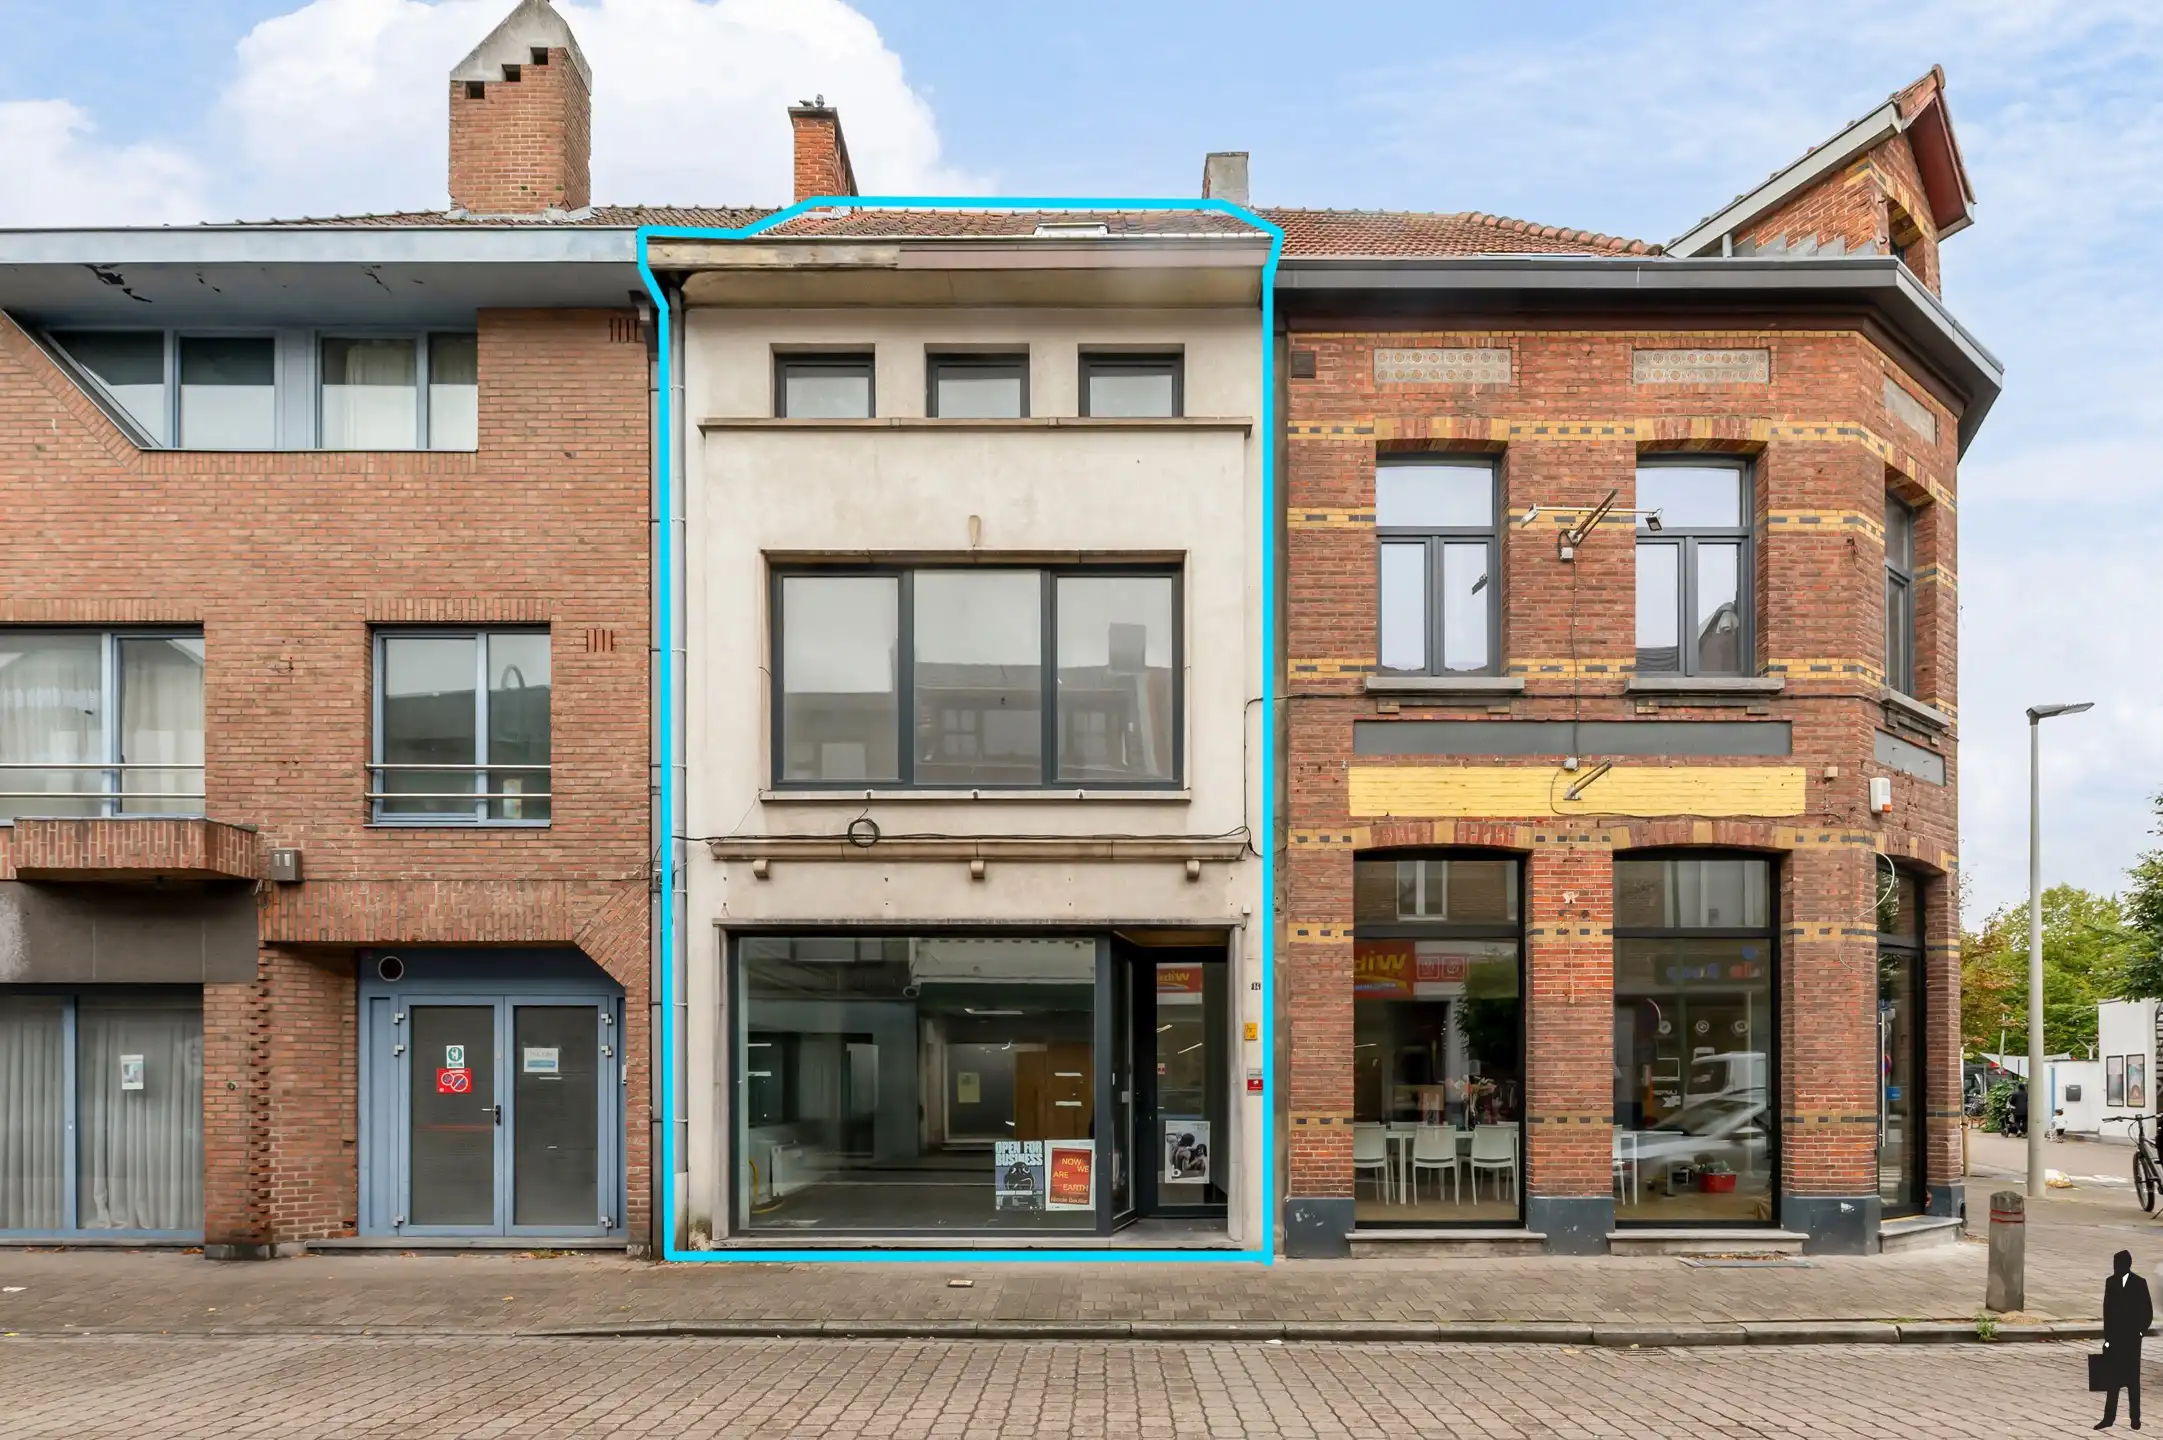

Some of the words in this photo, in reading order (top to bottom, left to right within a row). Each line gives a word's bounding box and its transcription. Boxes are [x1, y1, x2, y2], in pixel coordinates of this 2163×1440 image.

[995, 1141, 1021, 1154] OPEN
[1023, 1141, 1043, 1153] FOR
[995, 1153, 1043, 1166] BUSINESS
[1061, 1157, 1081, 1166] NOW
[1077, 1165, 1089, 1173] WE
[1062, 1183, 1089, 1192] EARTH
